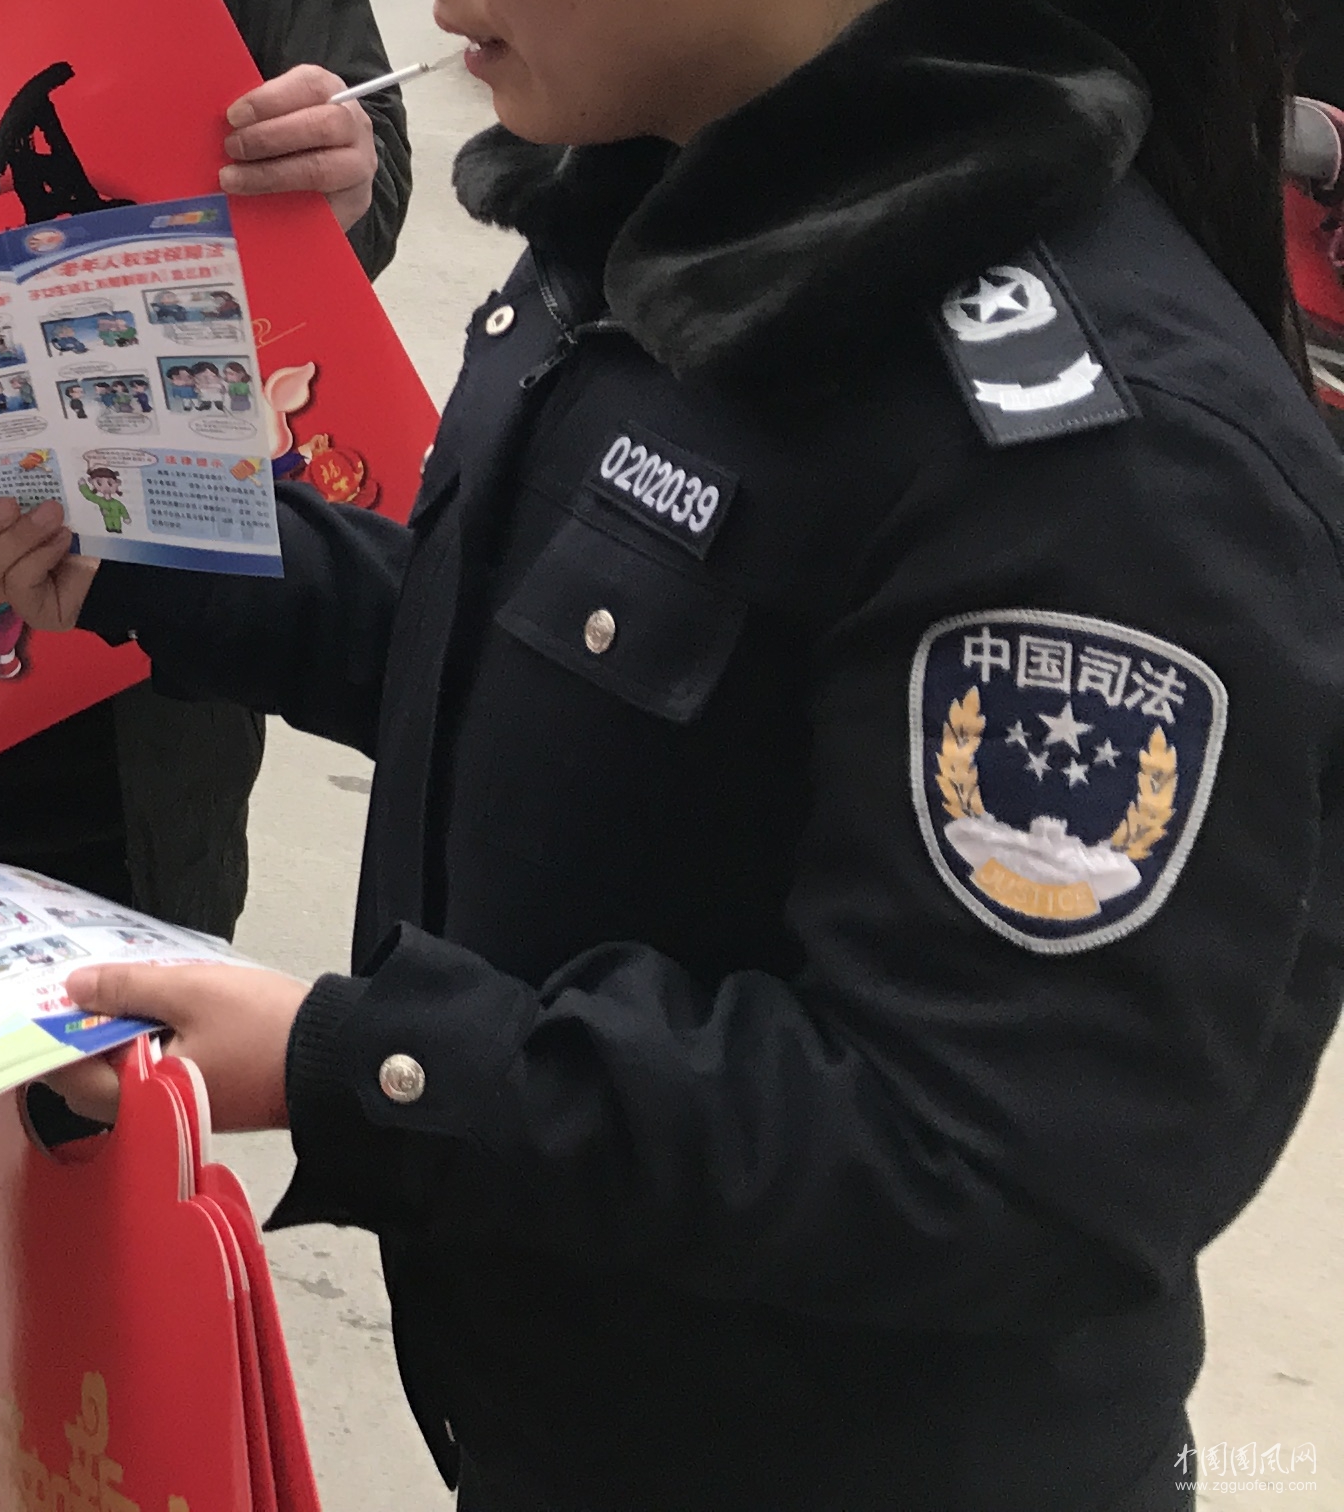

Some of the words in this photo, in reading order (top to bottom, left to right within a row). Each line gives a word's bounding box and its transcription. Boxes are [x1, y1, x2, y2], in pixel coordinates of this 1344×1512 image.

[600, 435, 720, 533] 0202039
[962, 628, 1188, 725] 中国司法
